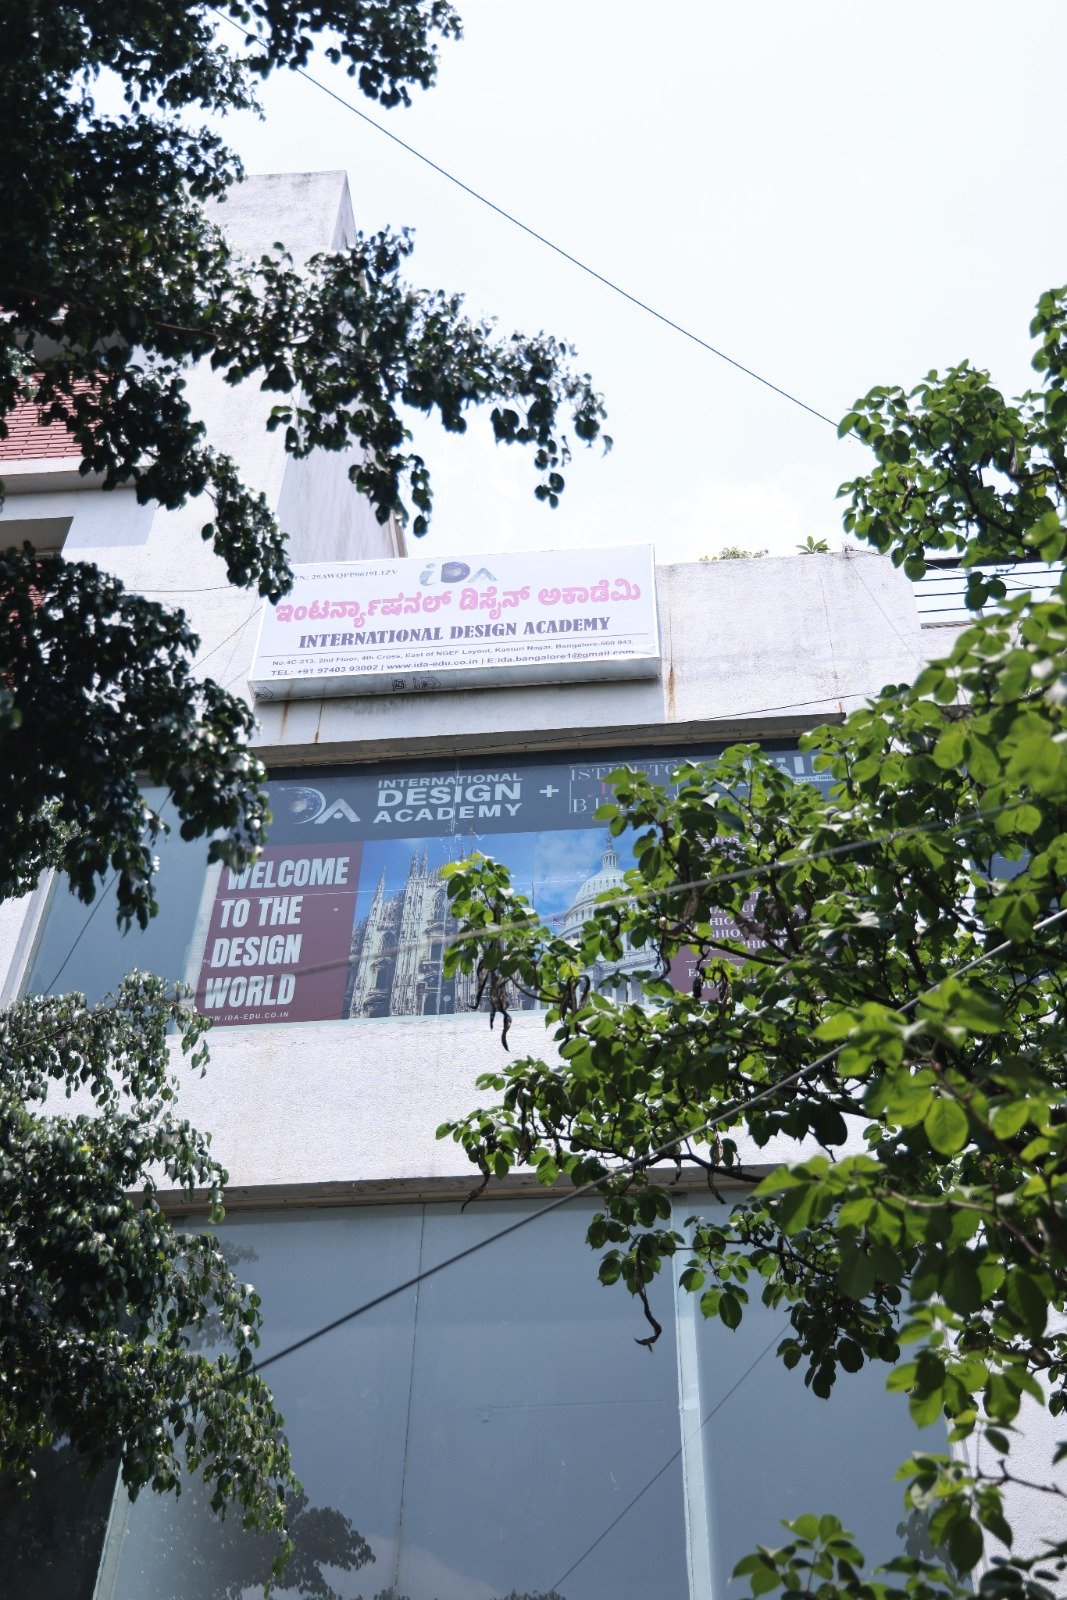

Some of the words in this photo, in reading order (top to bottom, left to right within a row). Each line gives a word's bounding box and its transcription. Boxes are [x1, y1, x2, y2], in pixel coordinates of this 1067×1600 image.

[298, 626, 443, 649] INTERNATIONAL
[449, 622, 518, 640] DESIGN
[523, 616, 611, 635] ACADEMY
[376, 652, 403, 660] Cross,
[425, 650, 435, 658] of
[436, 649, 459, 657] NGEF
[461, 646, 493, 656] Layout,
[495, 645, 525, 653] Kasturi
[526, 643, 555, 652] Nagar,
[271, 669, 294, 677] TEL:
[296, 667, 315, 675] +91
[317, 665, 347, 674] 97403
[386, 659, 478, 671] www.ida-edu.co.in
[377, 772, 523, 789] INTERNATIONAL
[377, 782, 521, 807] DESIGN
[372, 802, 523, 824] ACADEMY
[227, 856, 350, 890] WELCOME
[220, 898, 251, 928] TO
[258, 895, 304, 926] THE
[210, 933, 303, 968] DESIGN
[204, 973, 296, 1009] WORLD
